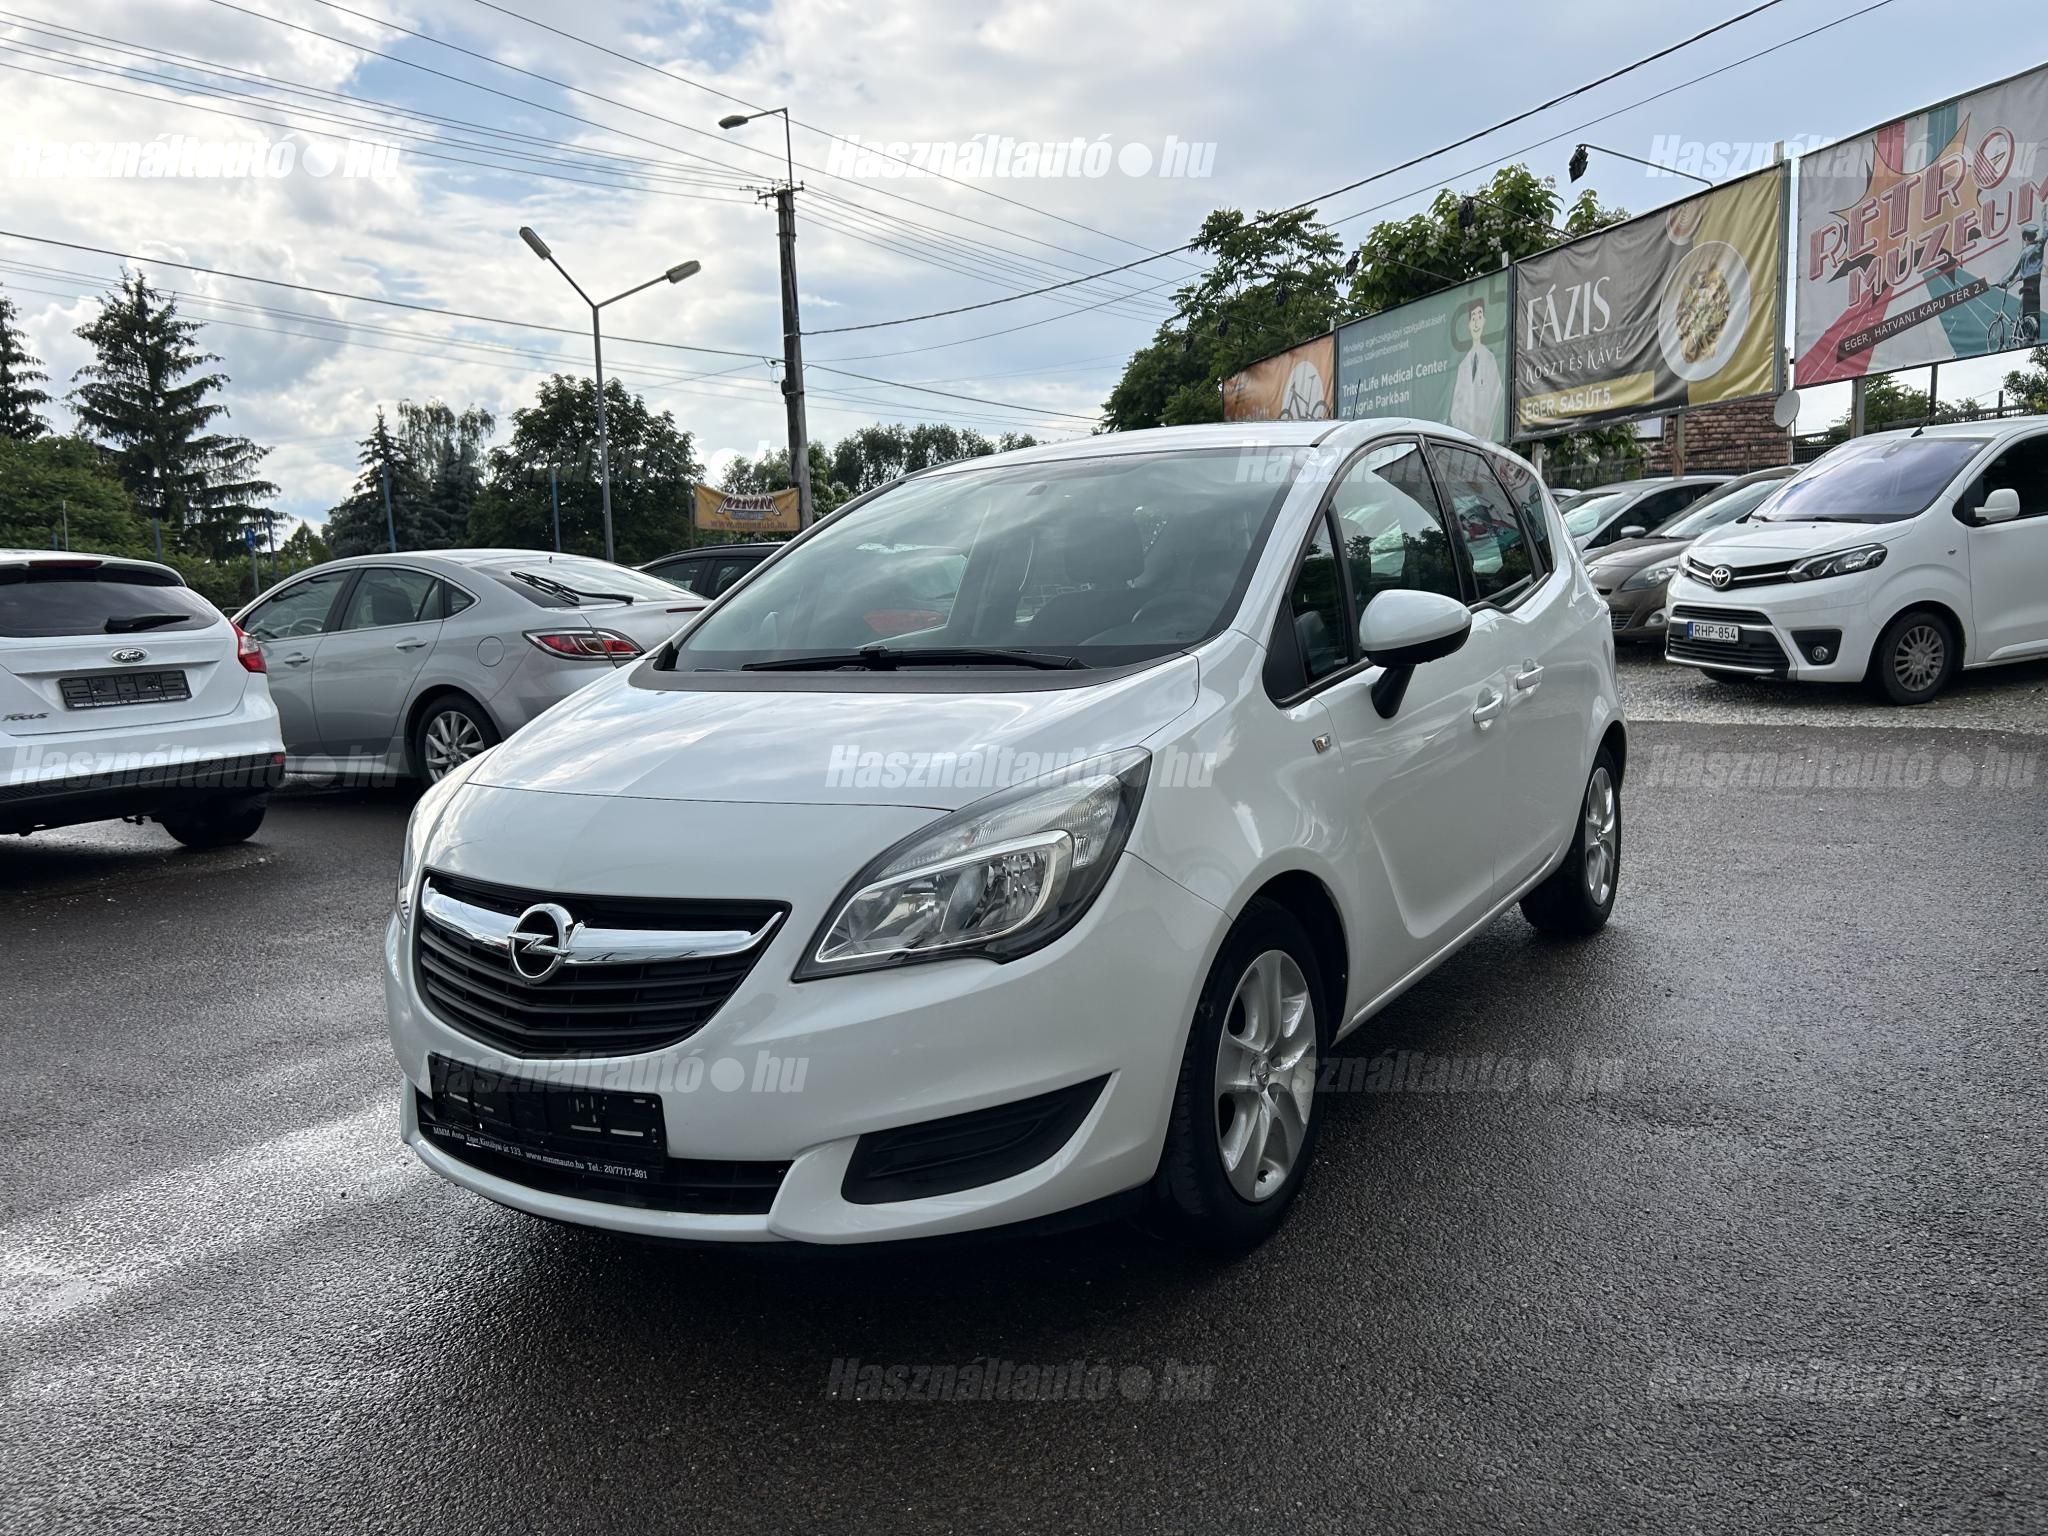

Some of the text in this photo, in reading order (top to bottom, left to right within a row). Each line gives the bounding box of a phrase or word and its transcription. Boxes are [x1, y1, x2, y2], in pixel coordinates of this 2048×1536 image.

[1808, 126, 2016, 281] RETRO
[1526, 276, 1611, 350] FÁZIS
[1844, 285, 1984, 352] EGER, HATVANI KAPU TÉR 2.
[1569, 353, 1583, 371] ÉS
[1587, 341, 1624, 370] KÁVÉ
[1343, 359, 1448, 398] TritonLife Medical Center
[1375, 390, 1410, 409] Parkban
[1559, 393, 1584, 413] SAS
[1585, 384, 1602, 408] ÚT
[1694, 624, 1736, 640] RHP-854
